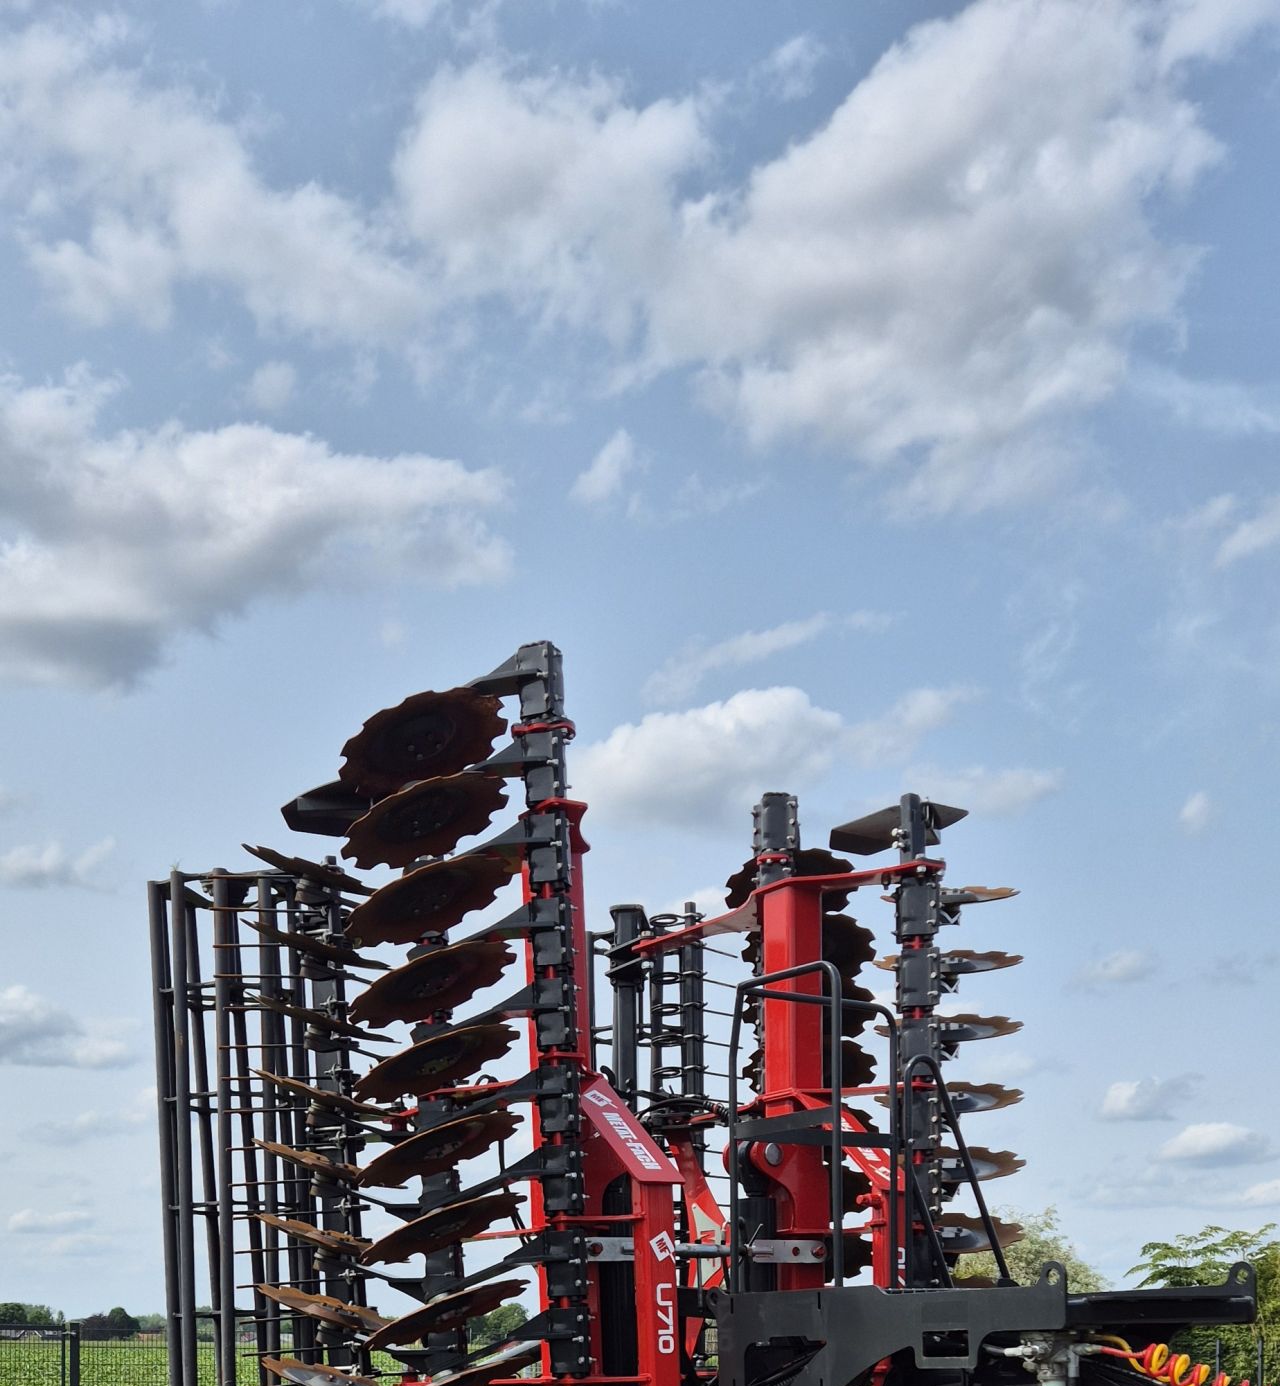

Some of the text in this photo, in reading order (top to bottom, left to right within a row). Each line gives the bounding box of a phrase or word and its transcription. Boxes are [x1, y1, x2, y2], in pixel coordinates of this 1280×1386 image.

[602, 1112, 662, 1170] METAL-FACH
[655, 1237, 669, 1254] MF
[656, 1283, 675, 1354] U710
